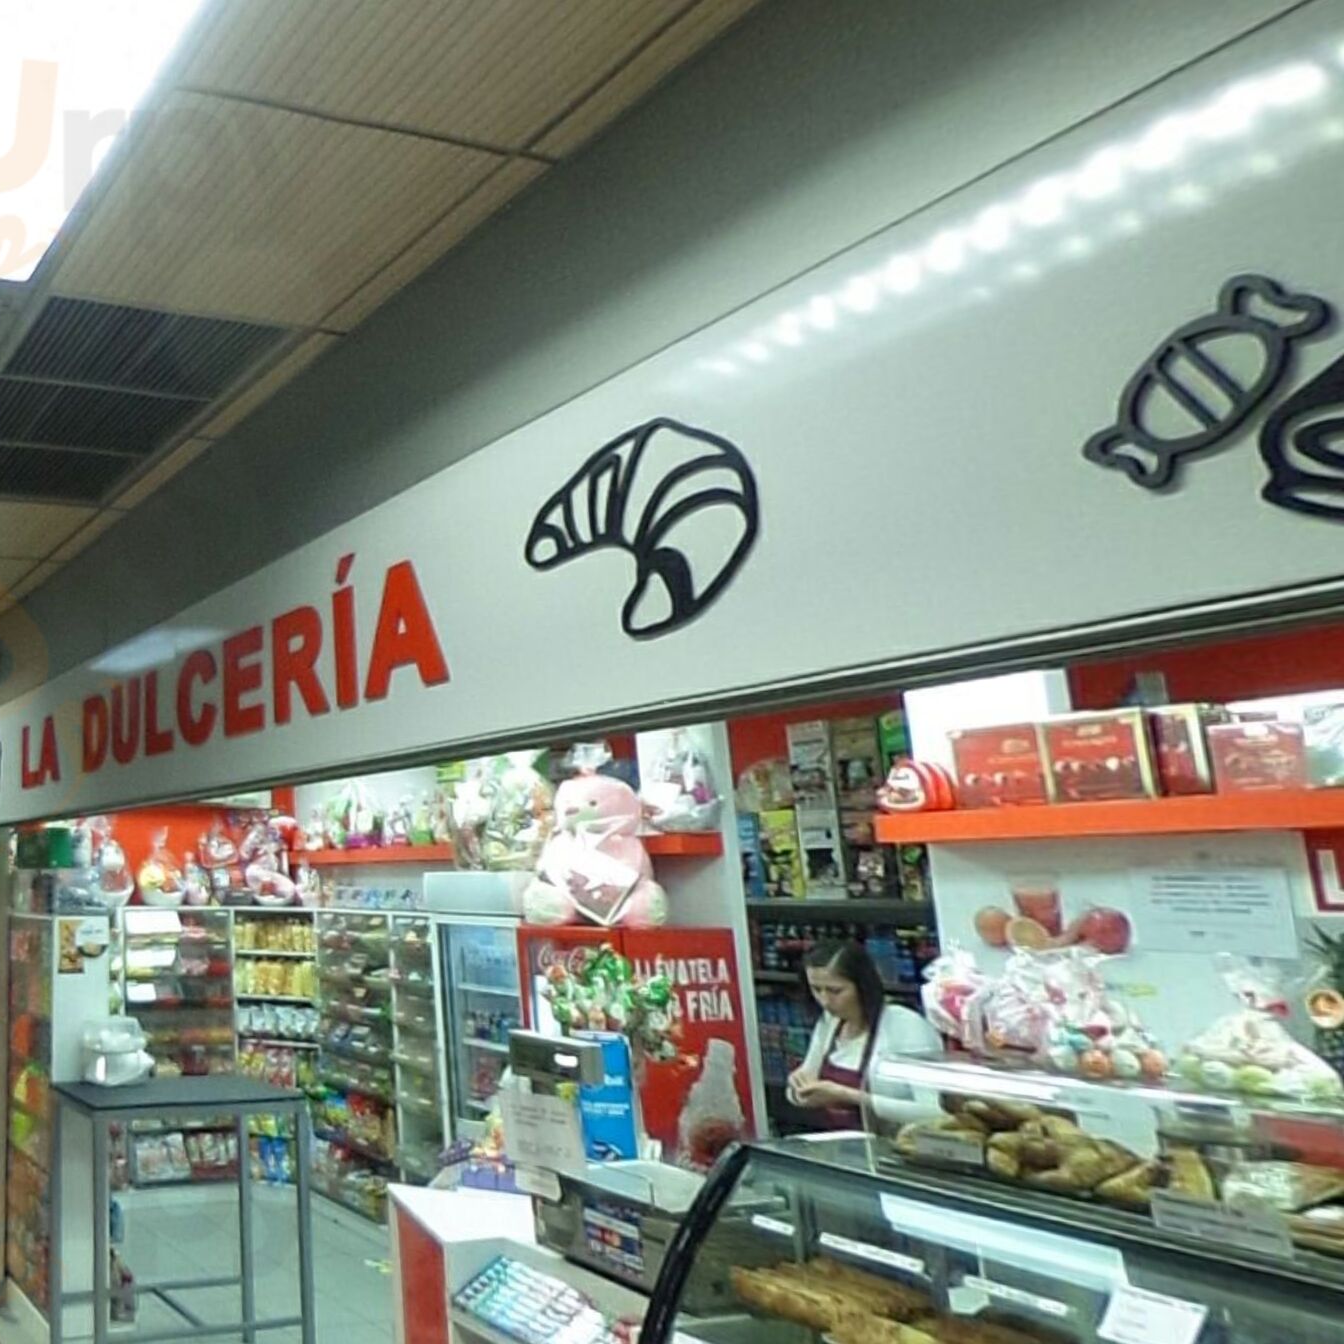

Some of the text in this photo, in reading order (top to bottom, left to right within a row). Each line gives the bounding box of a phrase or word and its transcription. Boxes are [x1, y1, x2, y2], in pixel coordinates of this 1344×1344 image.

[21, 715, 61, 790] LA
[82, 552, 451, 774] DULCERÍA
[686, 985, 735, 1023] FRÍA
